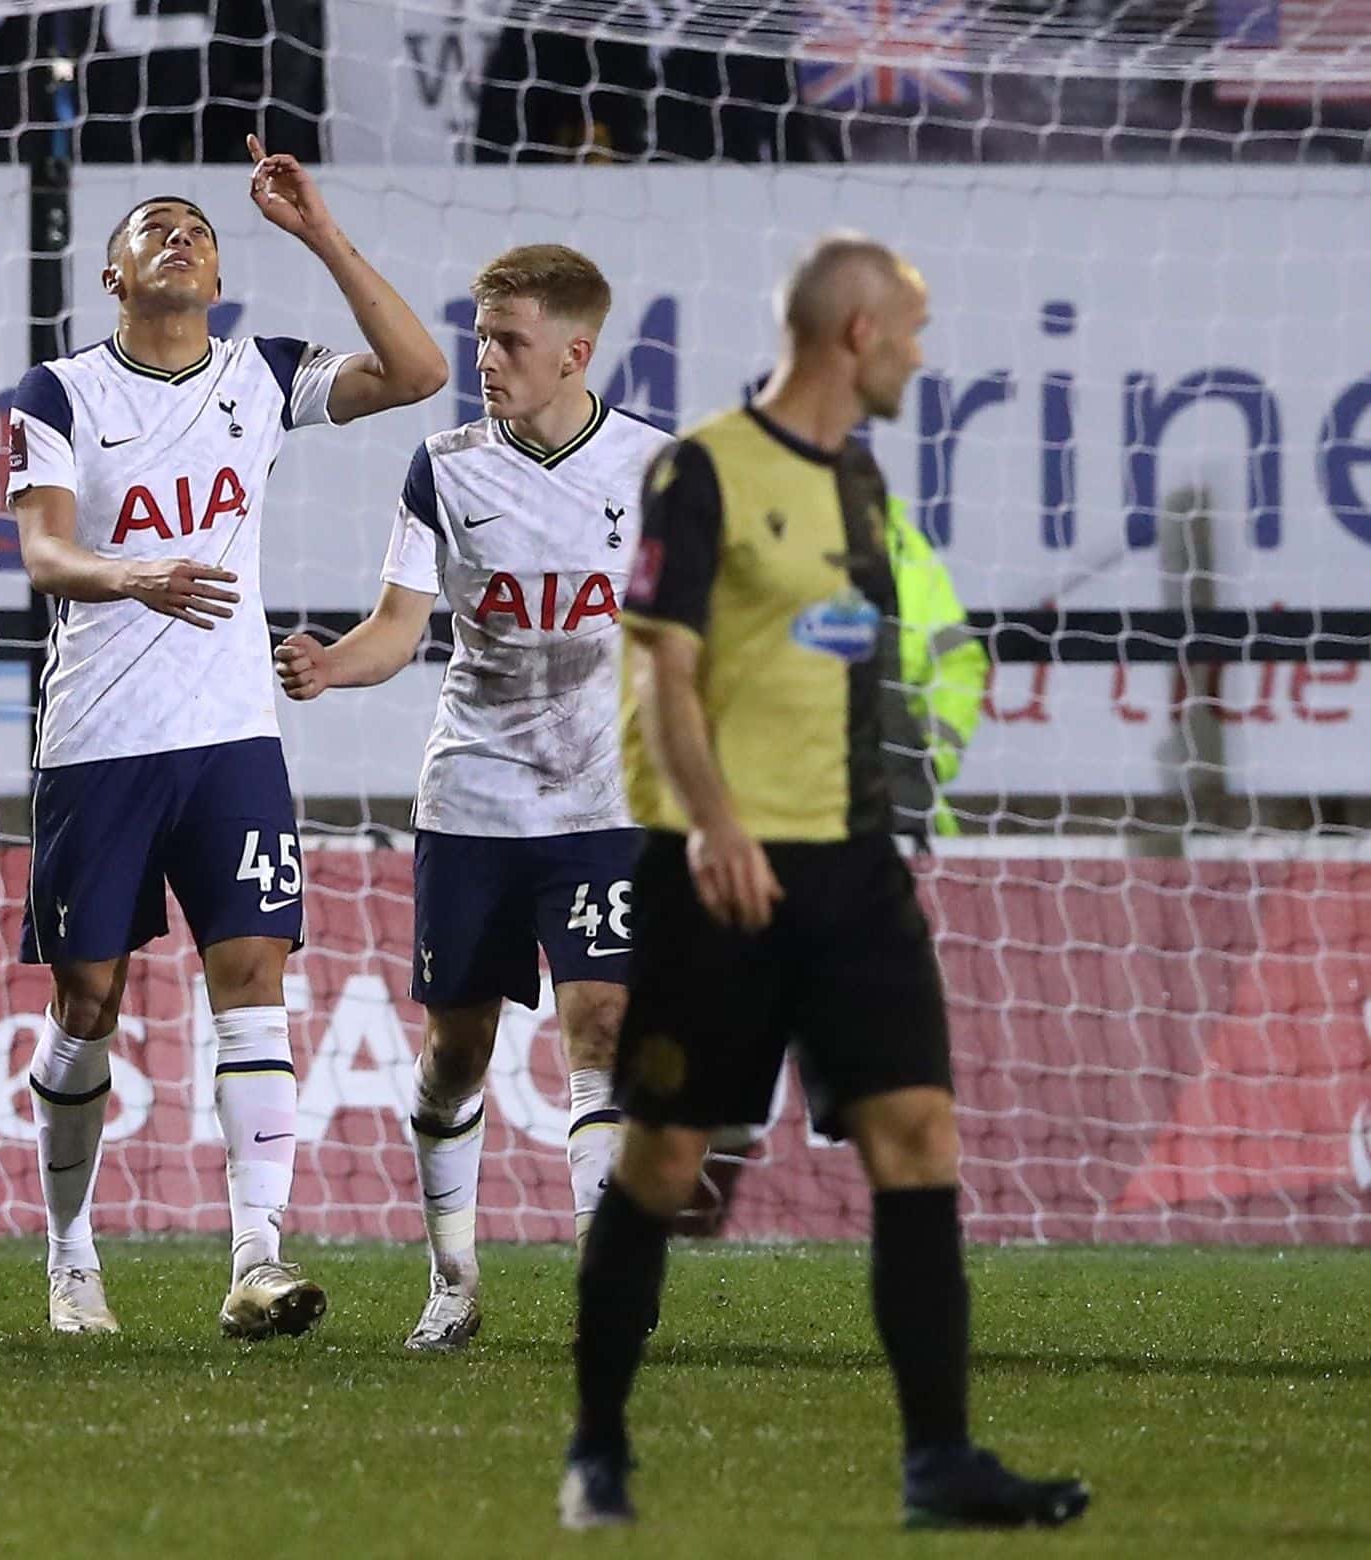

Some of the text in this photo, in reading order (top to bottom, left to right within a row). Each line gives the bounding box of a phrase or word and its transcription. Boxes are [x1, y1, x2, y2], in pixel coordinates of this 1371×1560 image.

[443, 296, 1371, 550] rin
[111, 467, 247, 545] AIA
[477, 572, 621, 631] AIA
[236, 830, 301, 895] 45
[567, 880, 632, 939] 48
